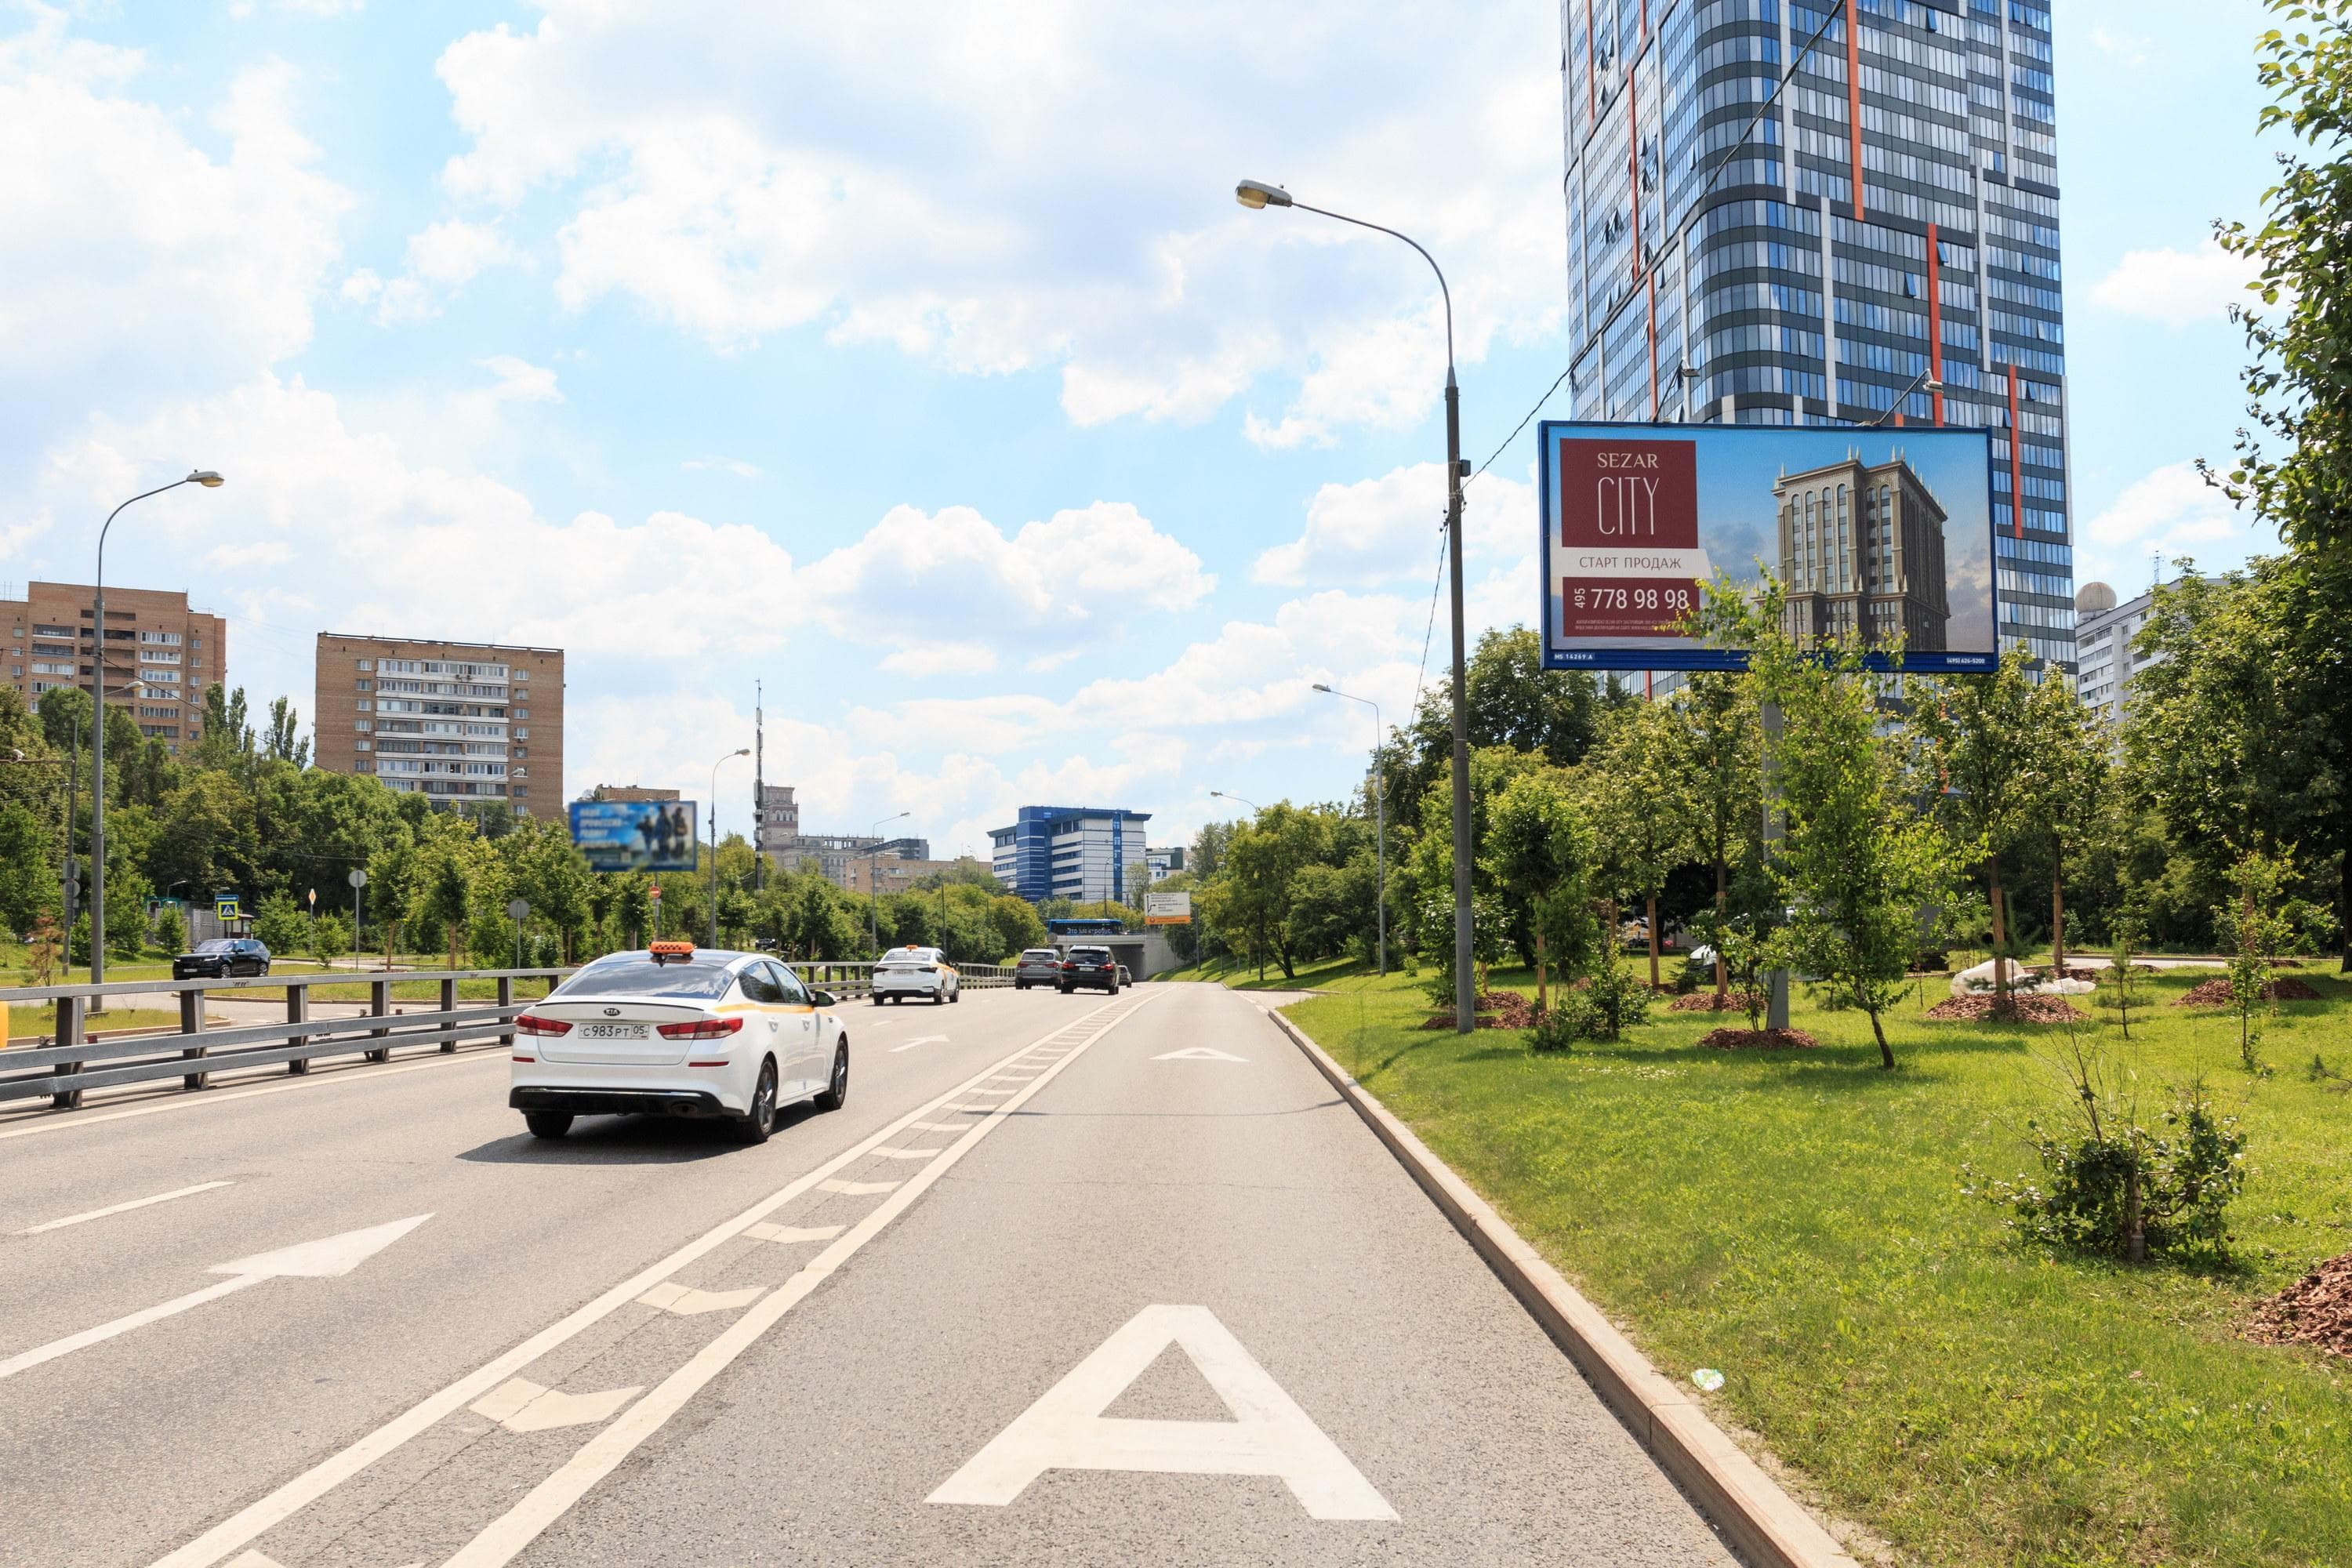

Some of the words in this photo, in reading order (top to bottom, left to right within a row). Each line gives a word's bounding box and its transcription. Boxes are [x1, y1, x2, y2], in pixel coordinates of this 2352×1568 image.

[1597, 452, 1659, 469] SEZAR
[1598, 477, 1660, 535] CITY
[1579, 557, 1619, 568] СТАРТ
[1624, 557, 1682, 571] ПРОДАЖ
[1574, 588, 1586, 608] 495
[1591, 589, 1628, 609] 778
[1634, 589, 1658, 609] 98
[1664, 590, 1689, 610] 98
[633, 1025, 644, 1035] 05
